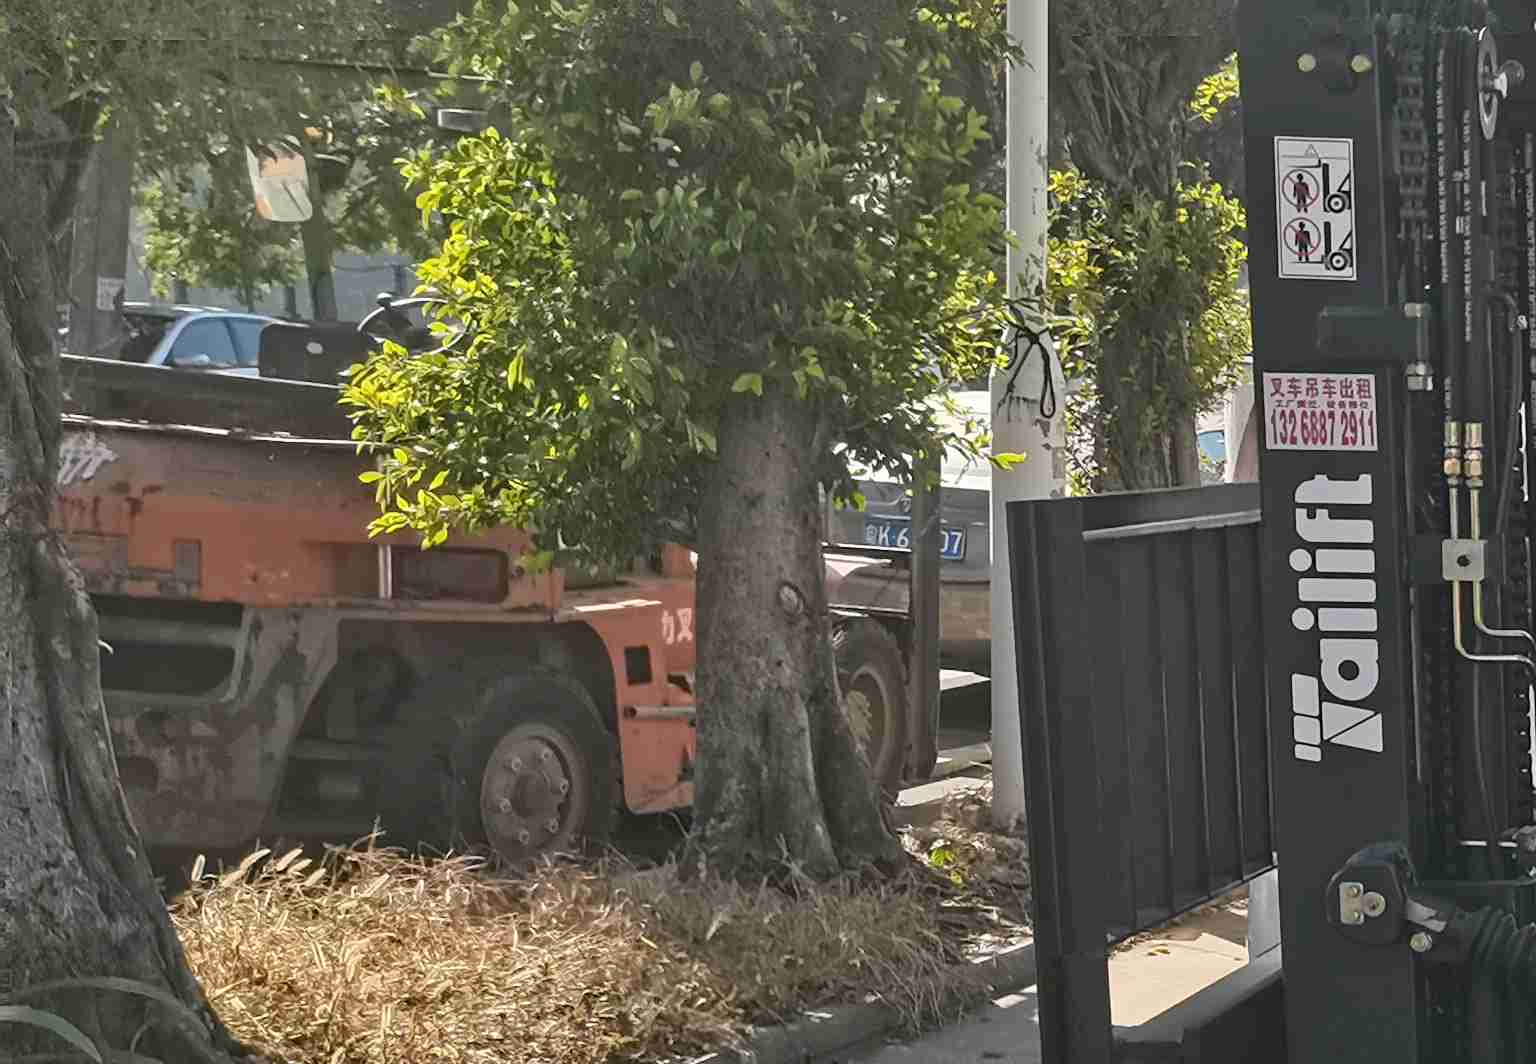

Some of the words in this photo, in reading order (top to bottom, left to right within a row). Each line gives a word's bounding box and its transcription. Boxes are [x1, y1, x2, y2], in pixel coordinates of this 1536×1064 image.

[1270, 377, 1371, 399] 叉车吊车出租
[1271, 408, 1297, 445] 132
[1300, 409, 1335, 446] 6887
[1340, 410, 1375, 447] 2911
[1290, 473, 1384, 763] Tailift
